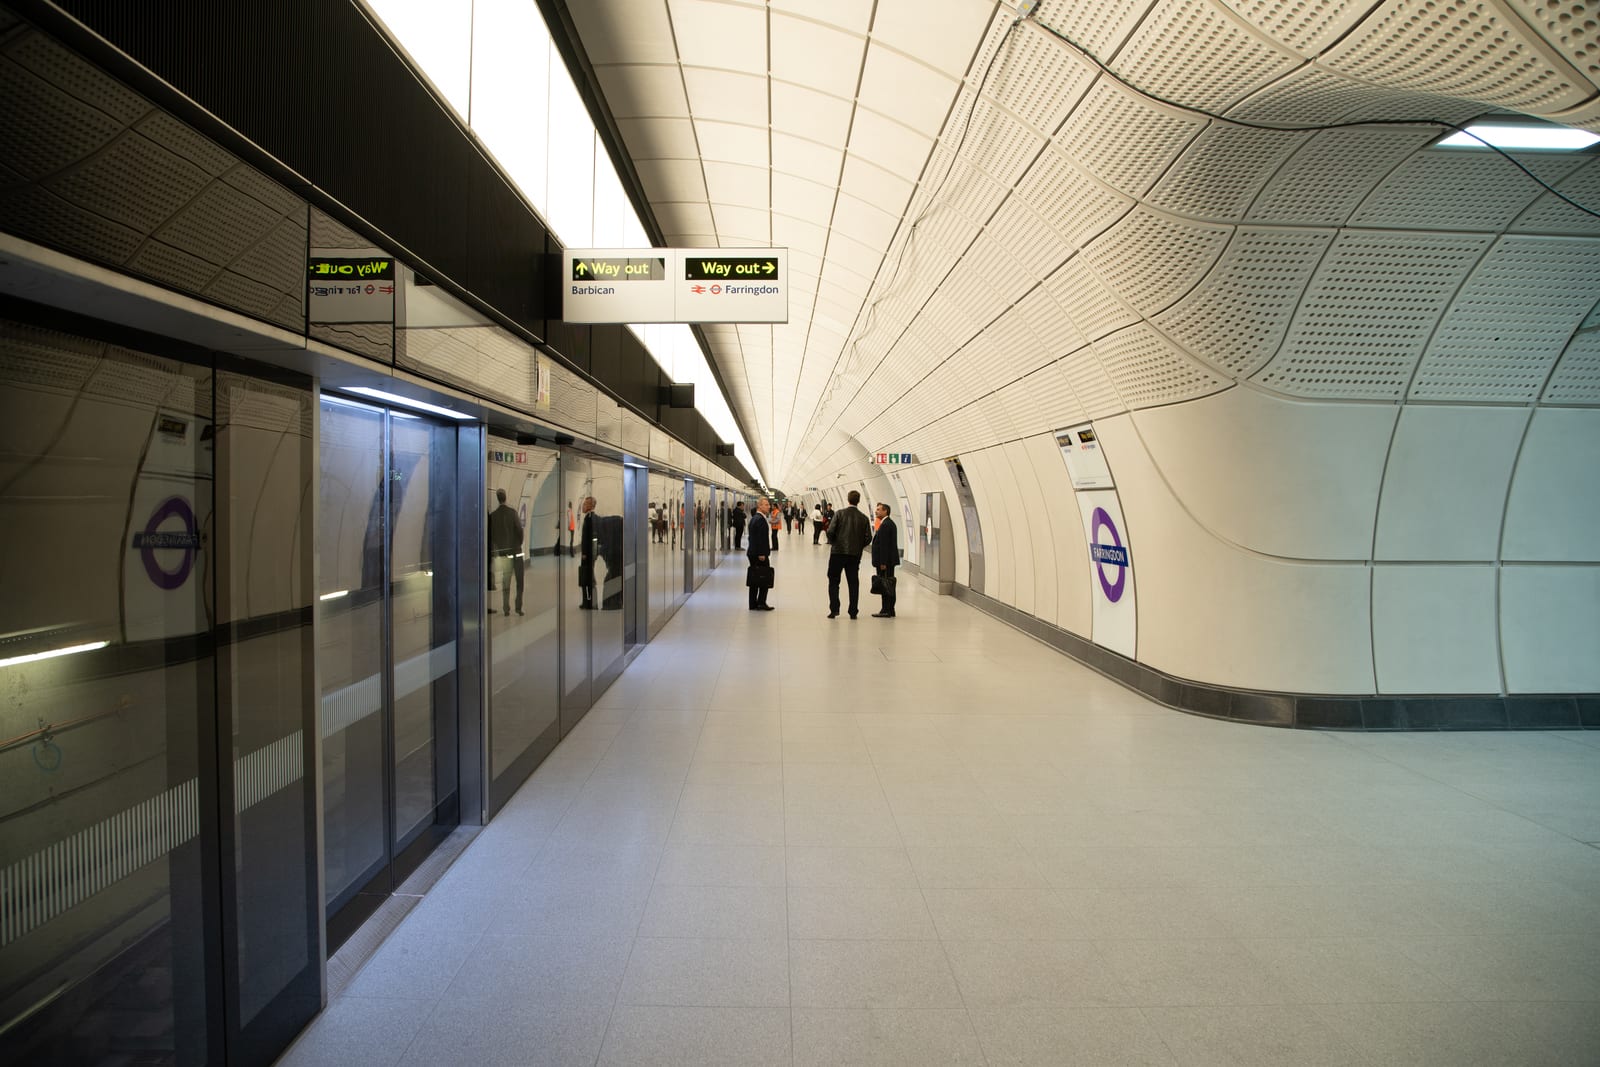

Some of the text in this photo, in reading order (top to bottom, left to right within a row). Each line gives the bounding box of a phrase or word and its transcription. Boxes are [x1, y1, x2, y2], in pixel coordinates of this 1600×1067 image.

[591, 262, 649, 277] Way out
[702, 261, 760, 277] Way out
[572, 285, 615, 295] Barbican
[725, 285, 779, 296] Farringdon
[1093, 546, 1125, 563] FARRINGDON
